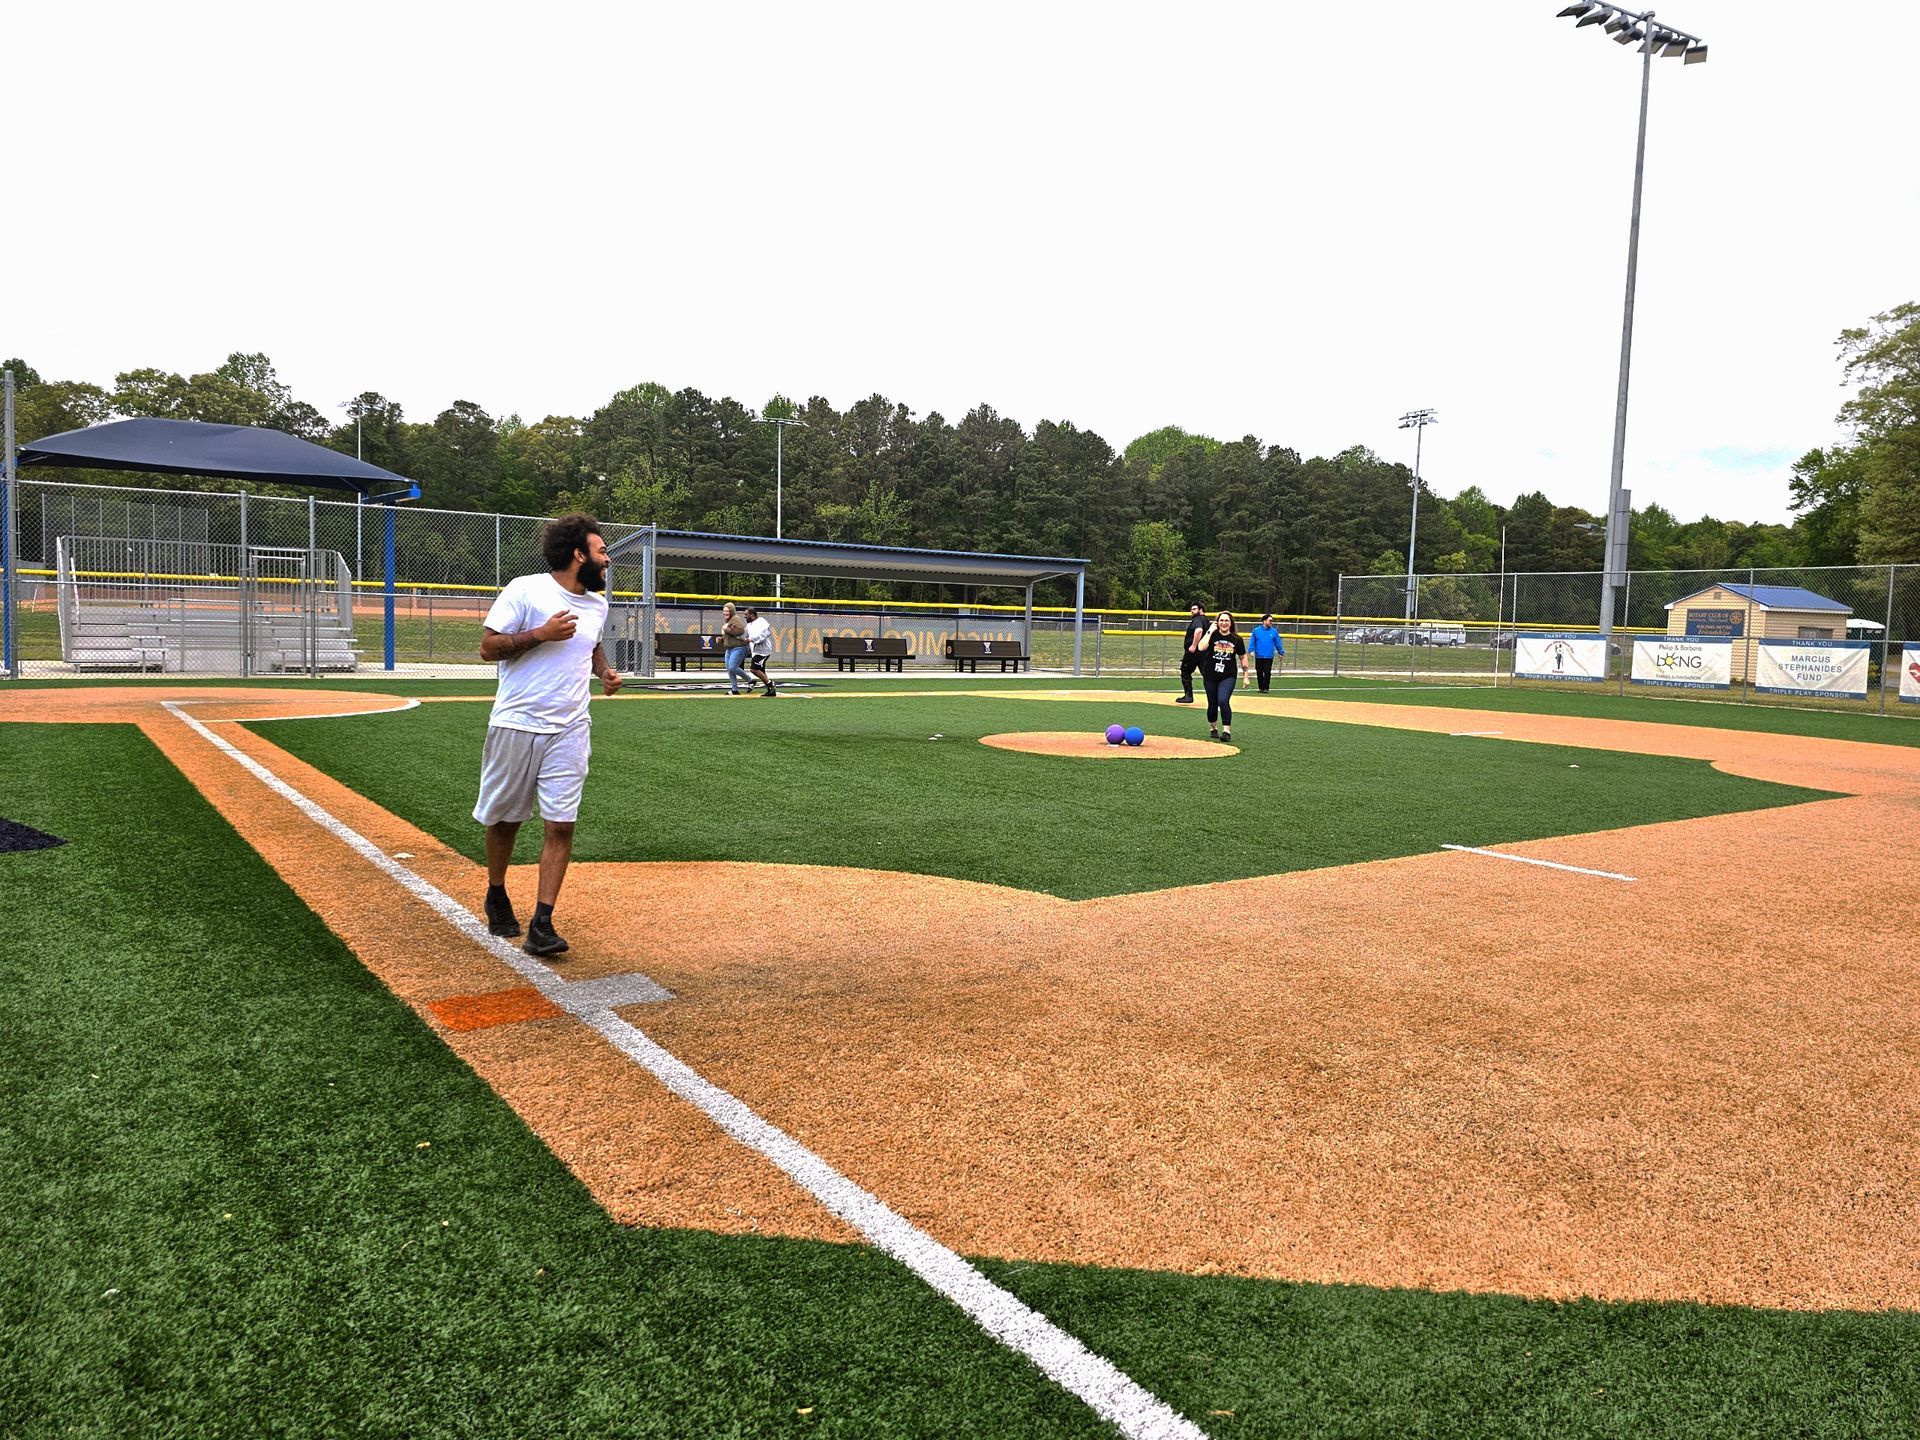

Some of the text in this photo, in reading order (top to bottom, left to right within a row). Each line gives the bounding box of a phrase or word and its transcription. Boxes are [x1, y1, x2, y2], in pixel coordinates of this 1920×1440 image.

[1791, 655, 1831, 663] MARCUS
[1778, 664, 1843, 673] STEPHANIDES
[1796, 674, 1822, 682] FUND
[1814, 691, 1850, 699] SPONSOR
